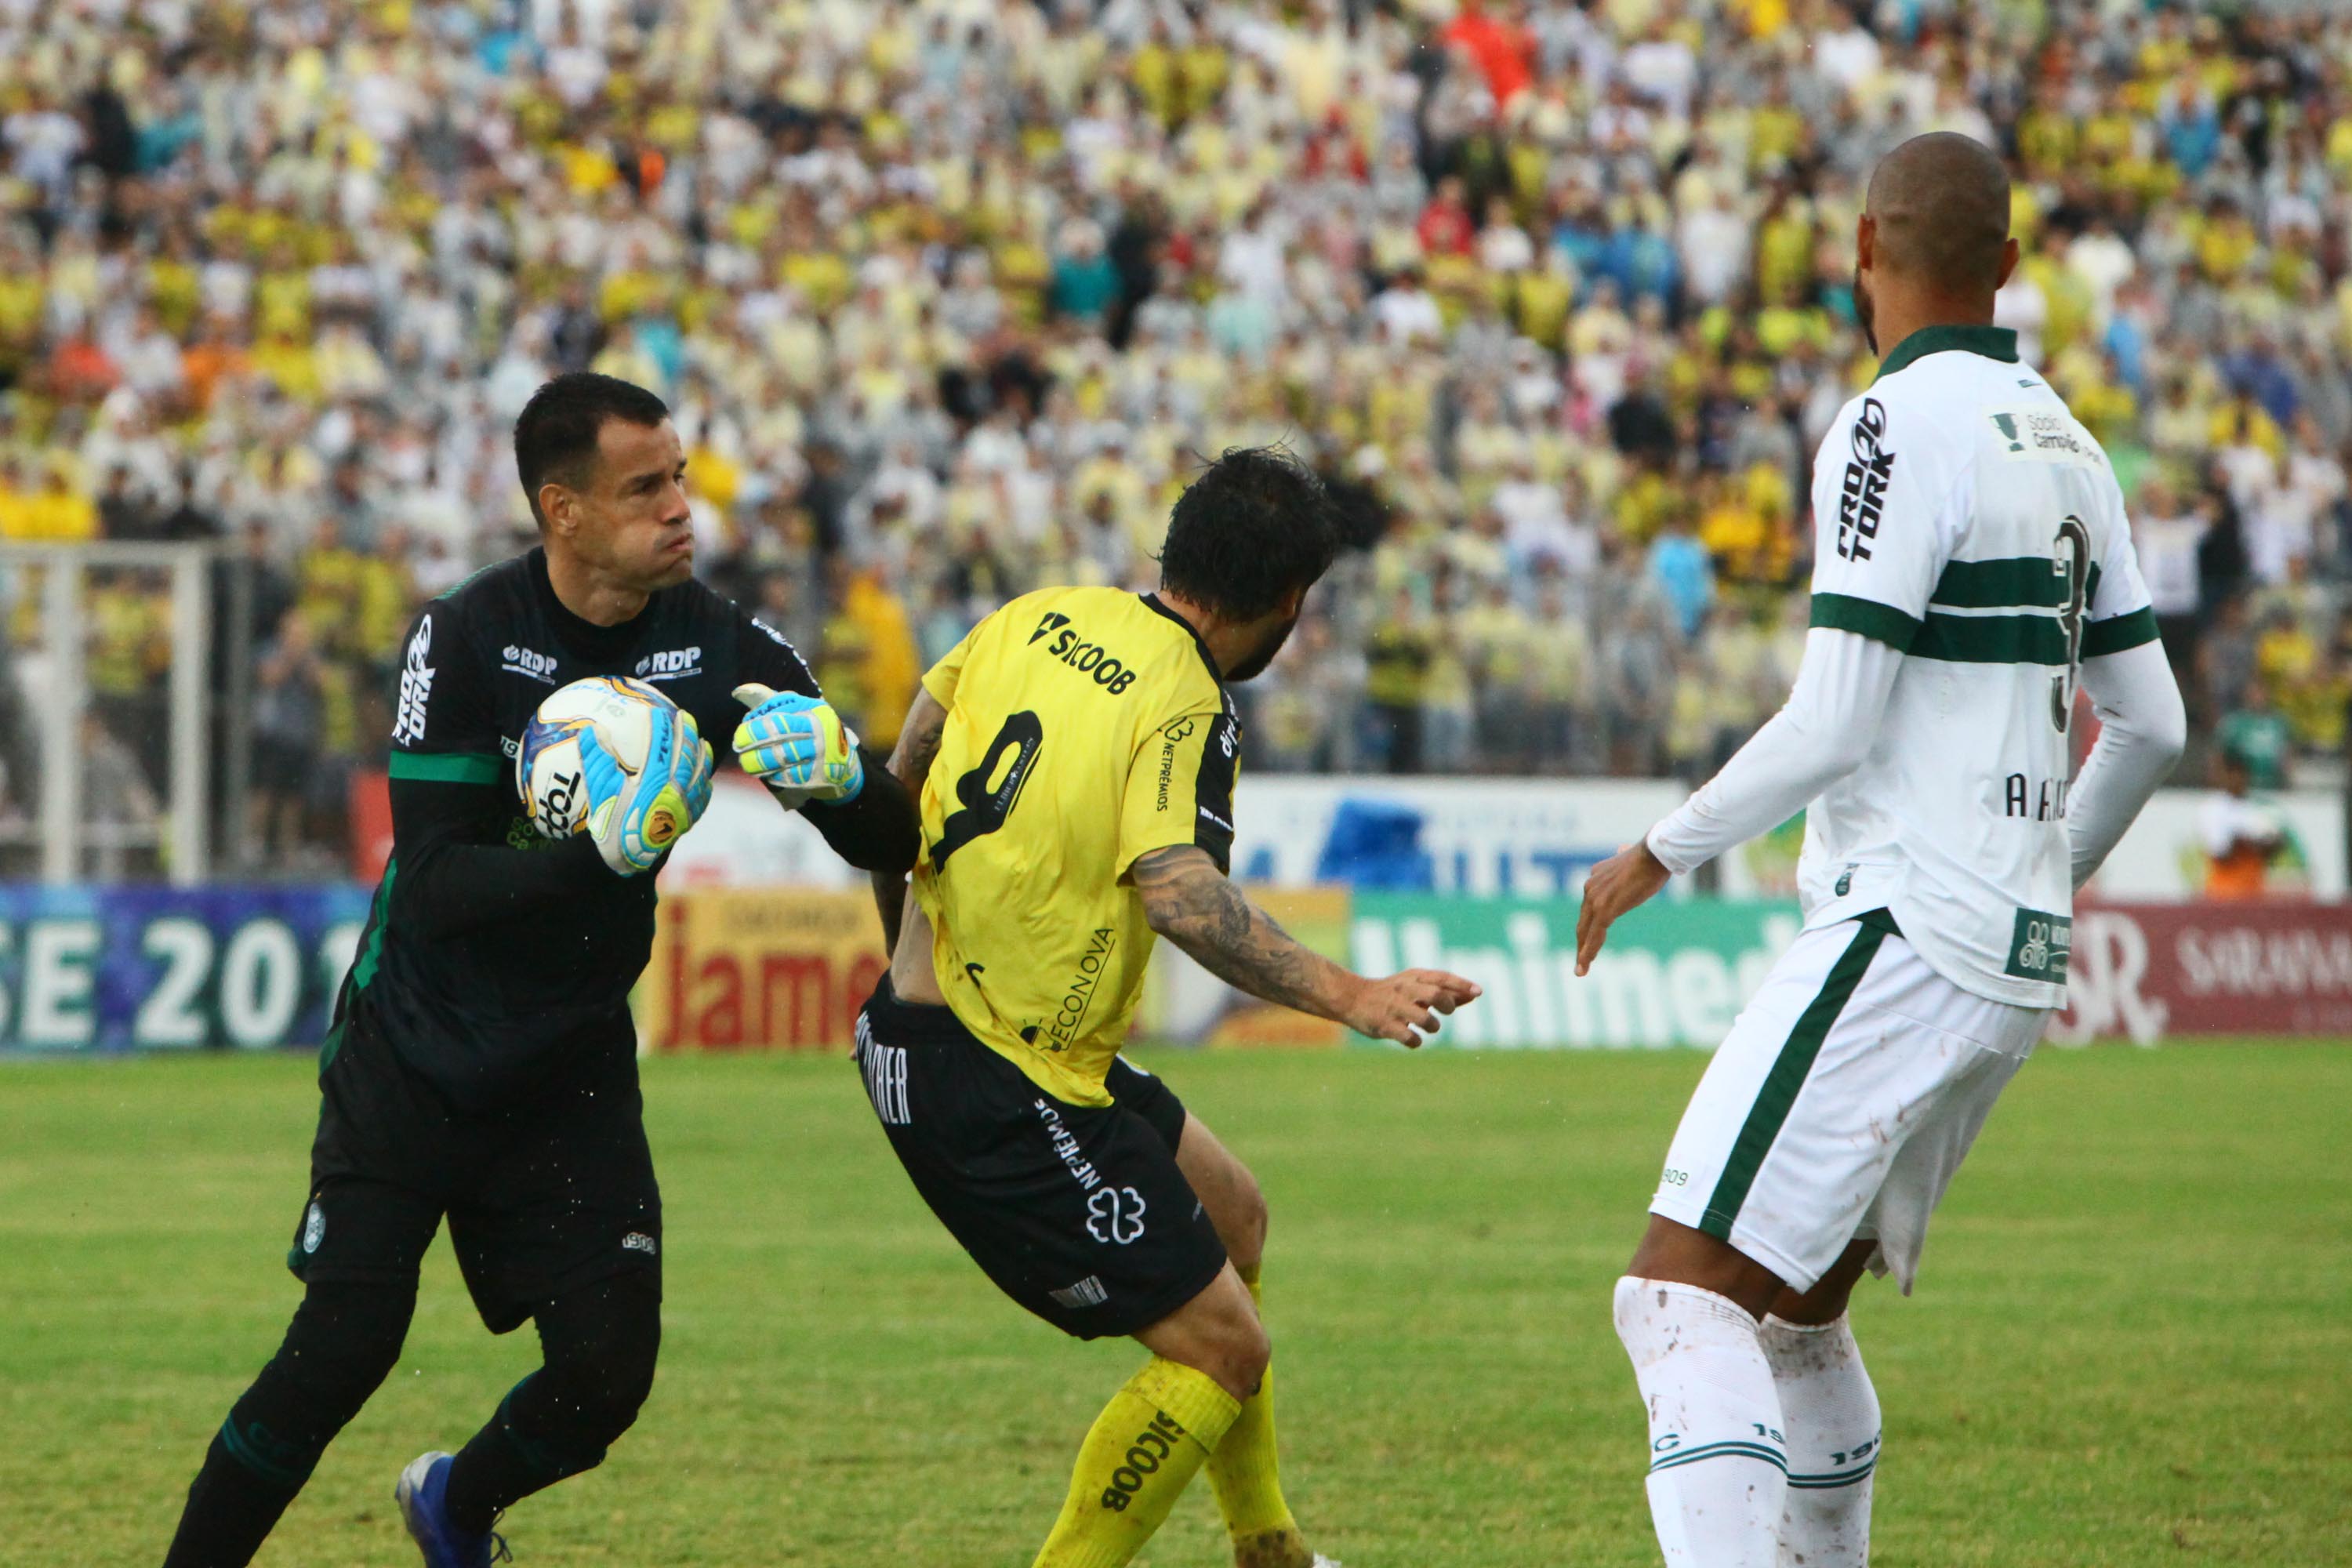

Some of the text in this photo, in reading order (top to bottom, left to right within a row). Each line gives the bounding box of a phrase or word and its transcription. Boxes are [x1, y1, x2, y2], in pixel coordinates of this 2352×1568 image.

[1850, 441, 1896, 562] TORK
[520, 648, 557, 675] RDP
[652, 646, 702, 673] RDP
[1048, 630, 1137, 695] SICOOB
[1051, 928, 1114, 1041] ECONOVA
[1101, 1410, 1185, 1512] SICOOB
